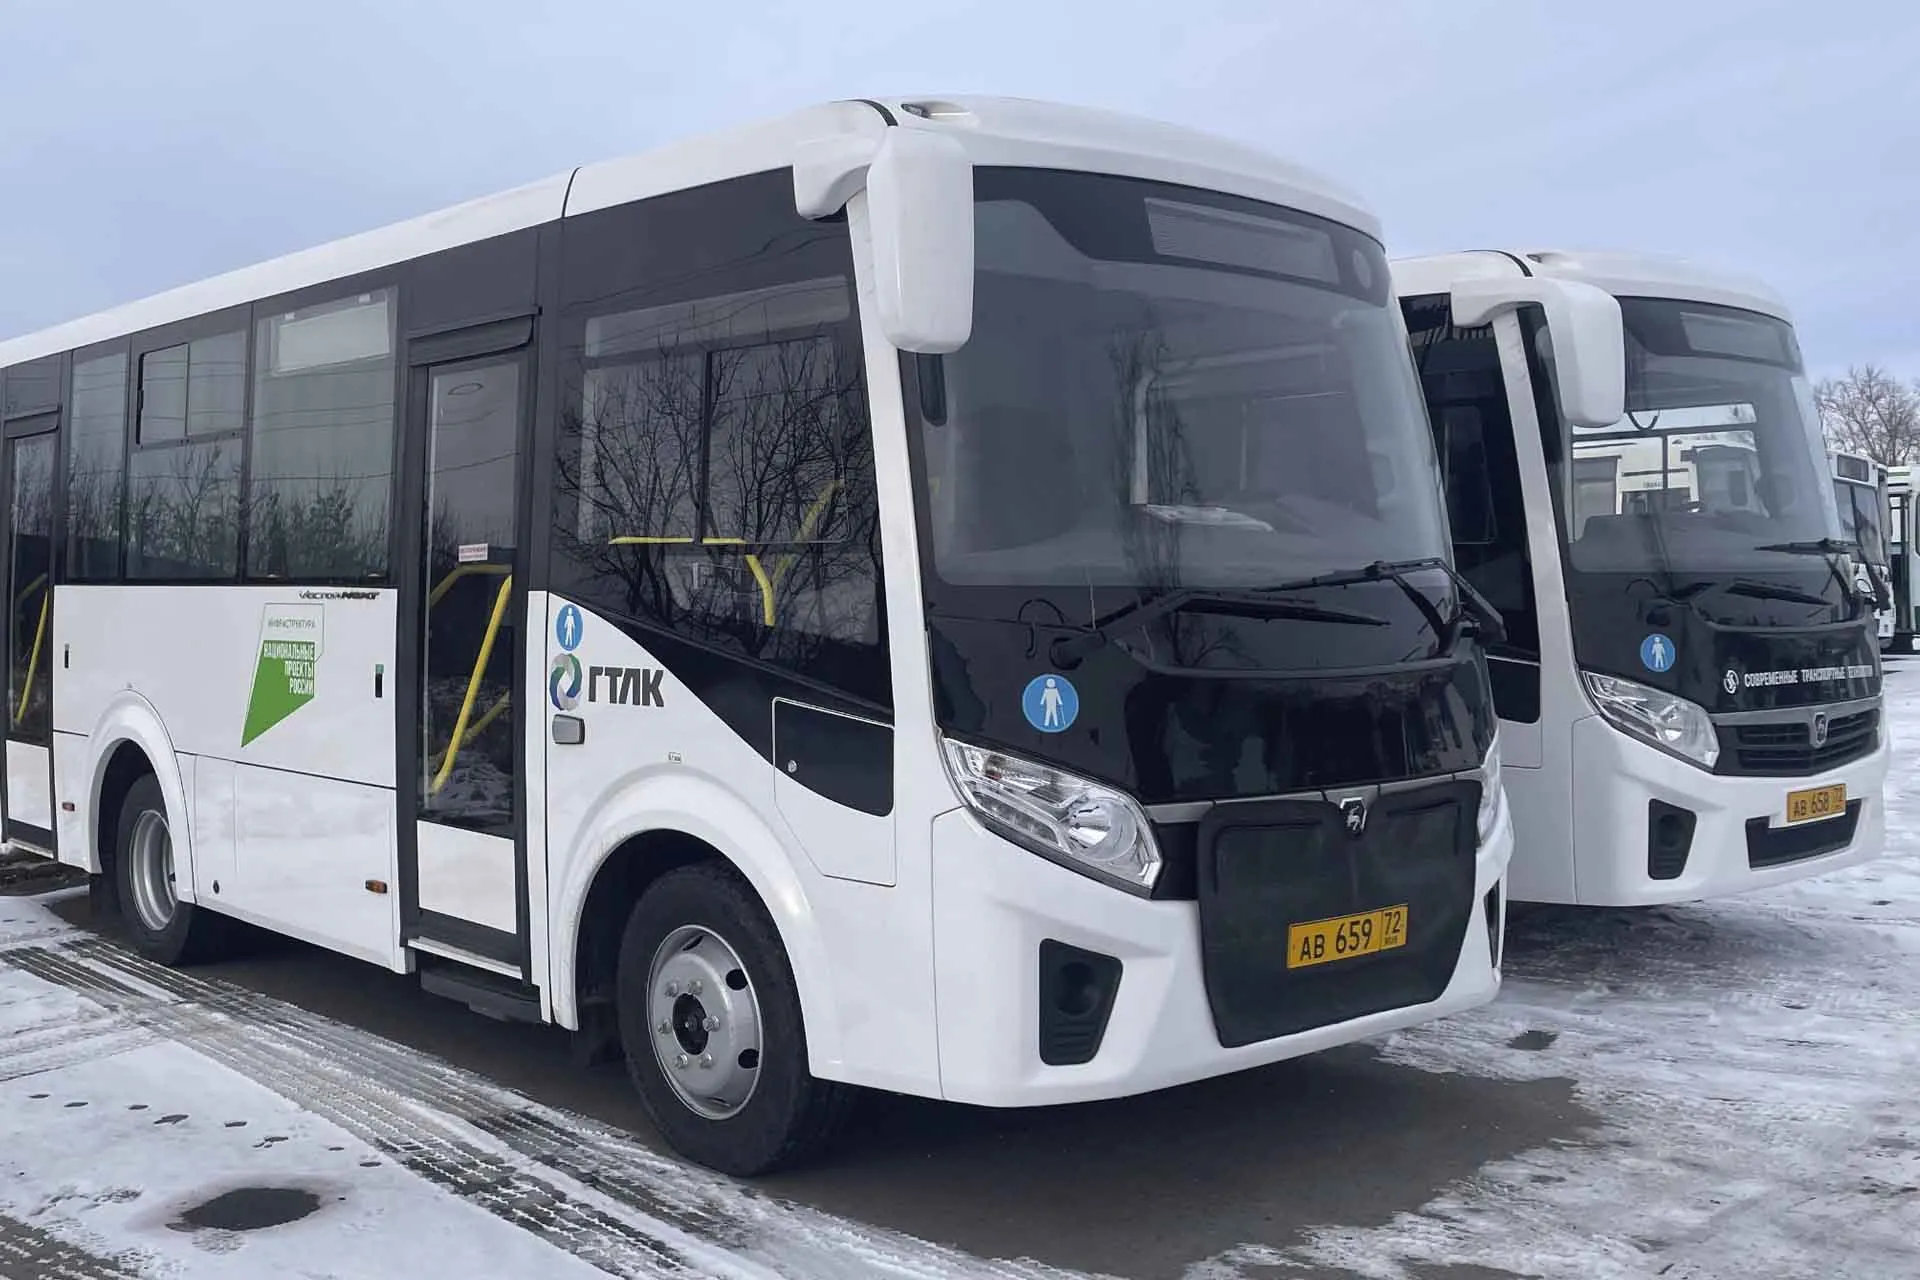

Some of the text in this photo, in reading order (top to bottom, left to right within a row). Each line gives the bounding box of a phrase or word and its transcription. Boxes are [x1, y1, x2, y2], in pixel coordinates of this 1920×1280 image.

[263, 642, 314, 660] НАЦИОНАЛЬНЫЕ
[284, 660, 313, 678] ПРОЕКТЫ
[289, 678, 313, 696] РОССИИ
[588, 665, 664, 707] ГТЛК
[1300, 911, 1400, 960] АВ 659 72
